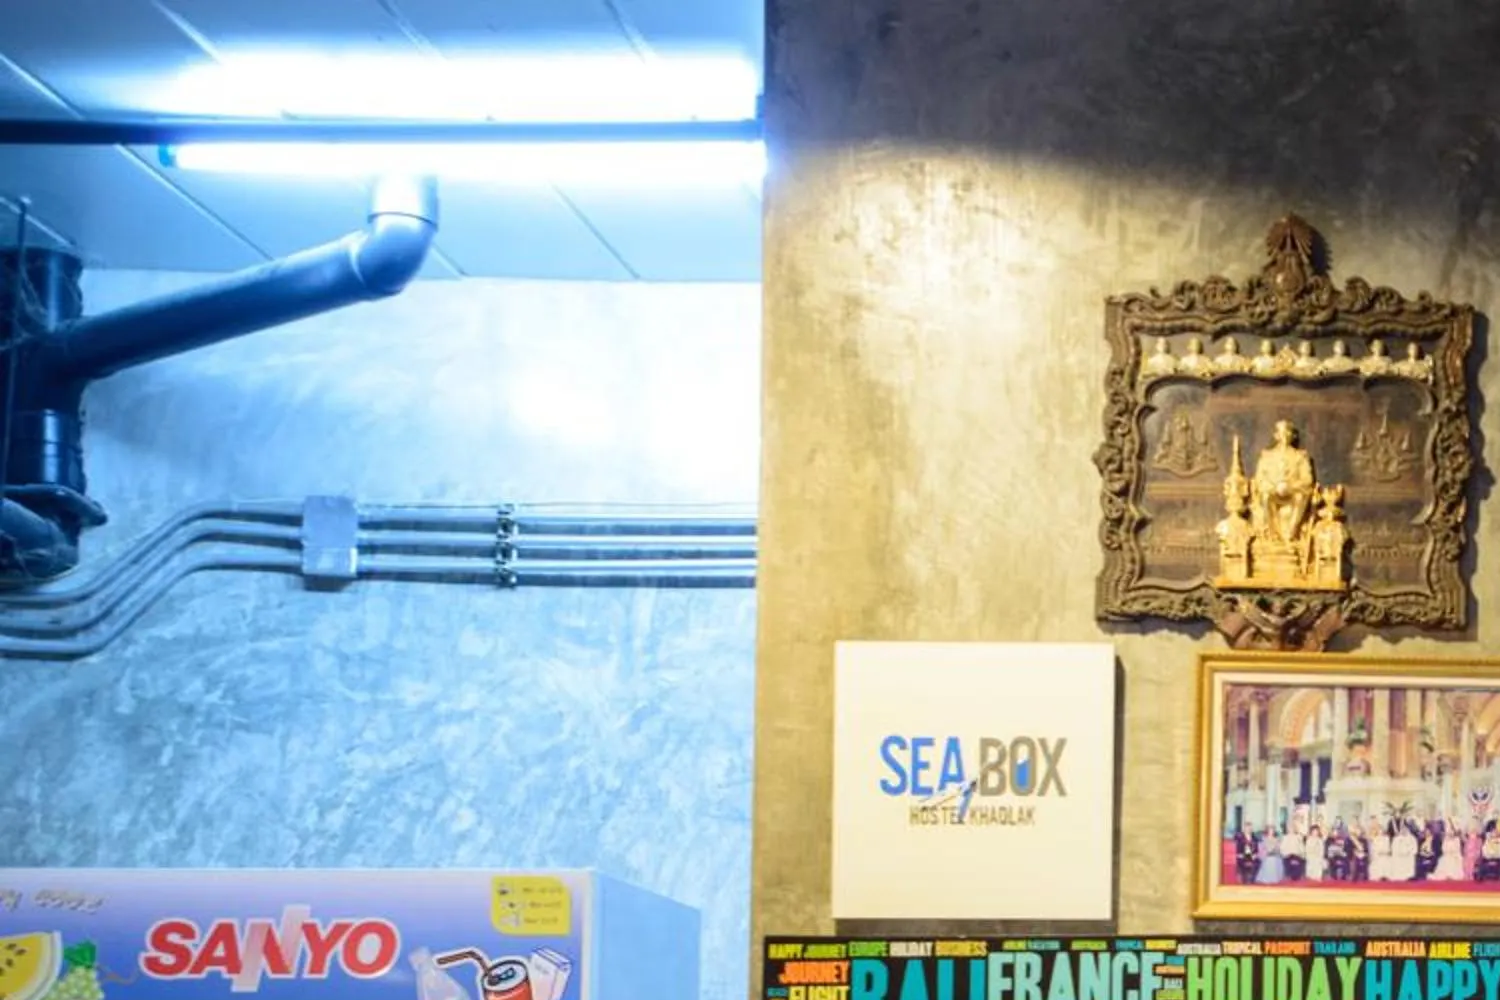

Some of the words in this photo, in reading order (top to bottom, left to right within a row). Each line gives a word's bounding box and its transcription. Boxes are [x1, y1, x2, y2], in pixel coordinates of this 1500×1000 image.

[879, 735, 966, 798] SEA
[979, 736, 1068, 797] BOX
[141, 904, 400, 992] SANYO
[890, 941, 933, 957] HOLIDAY
[1365, 941, 1426, 957] AUSTRALIA
[1429, 941, 1472, 958] AIRLINE
[778, 961, 849, 984] JOURNEY
